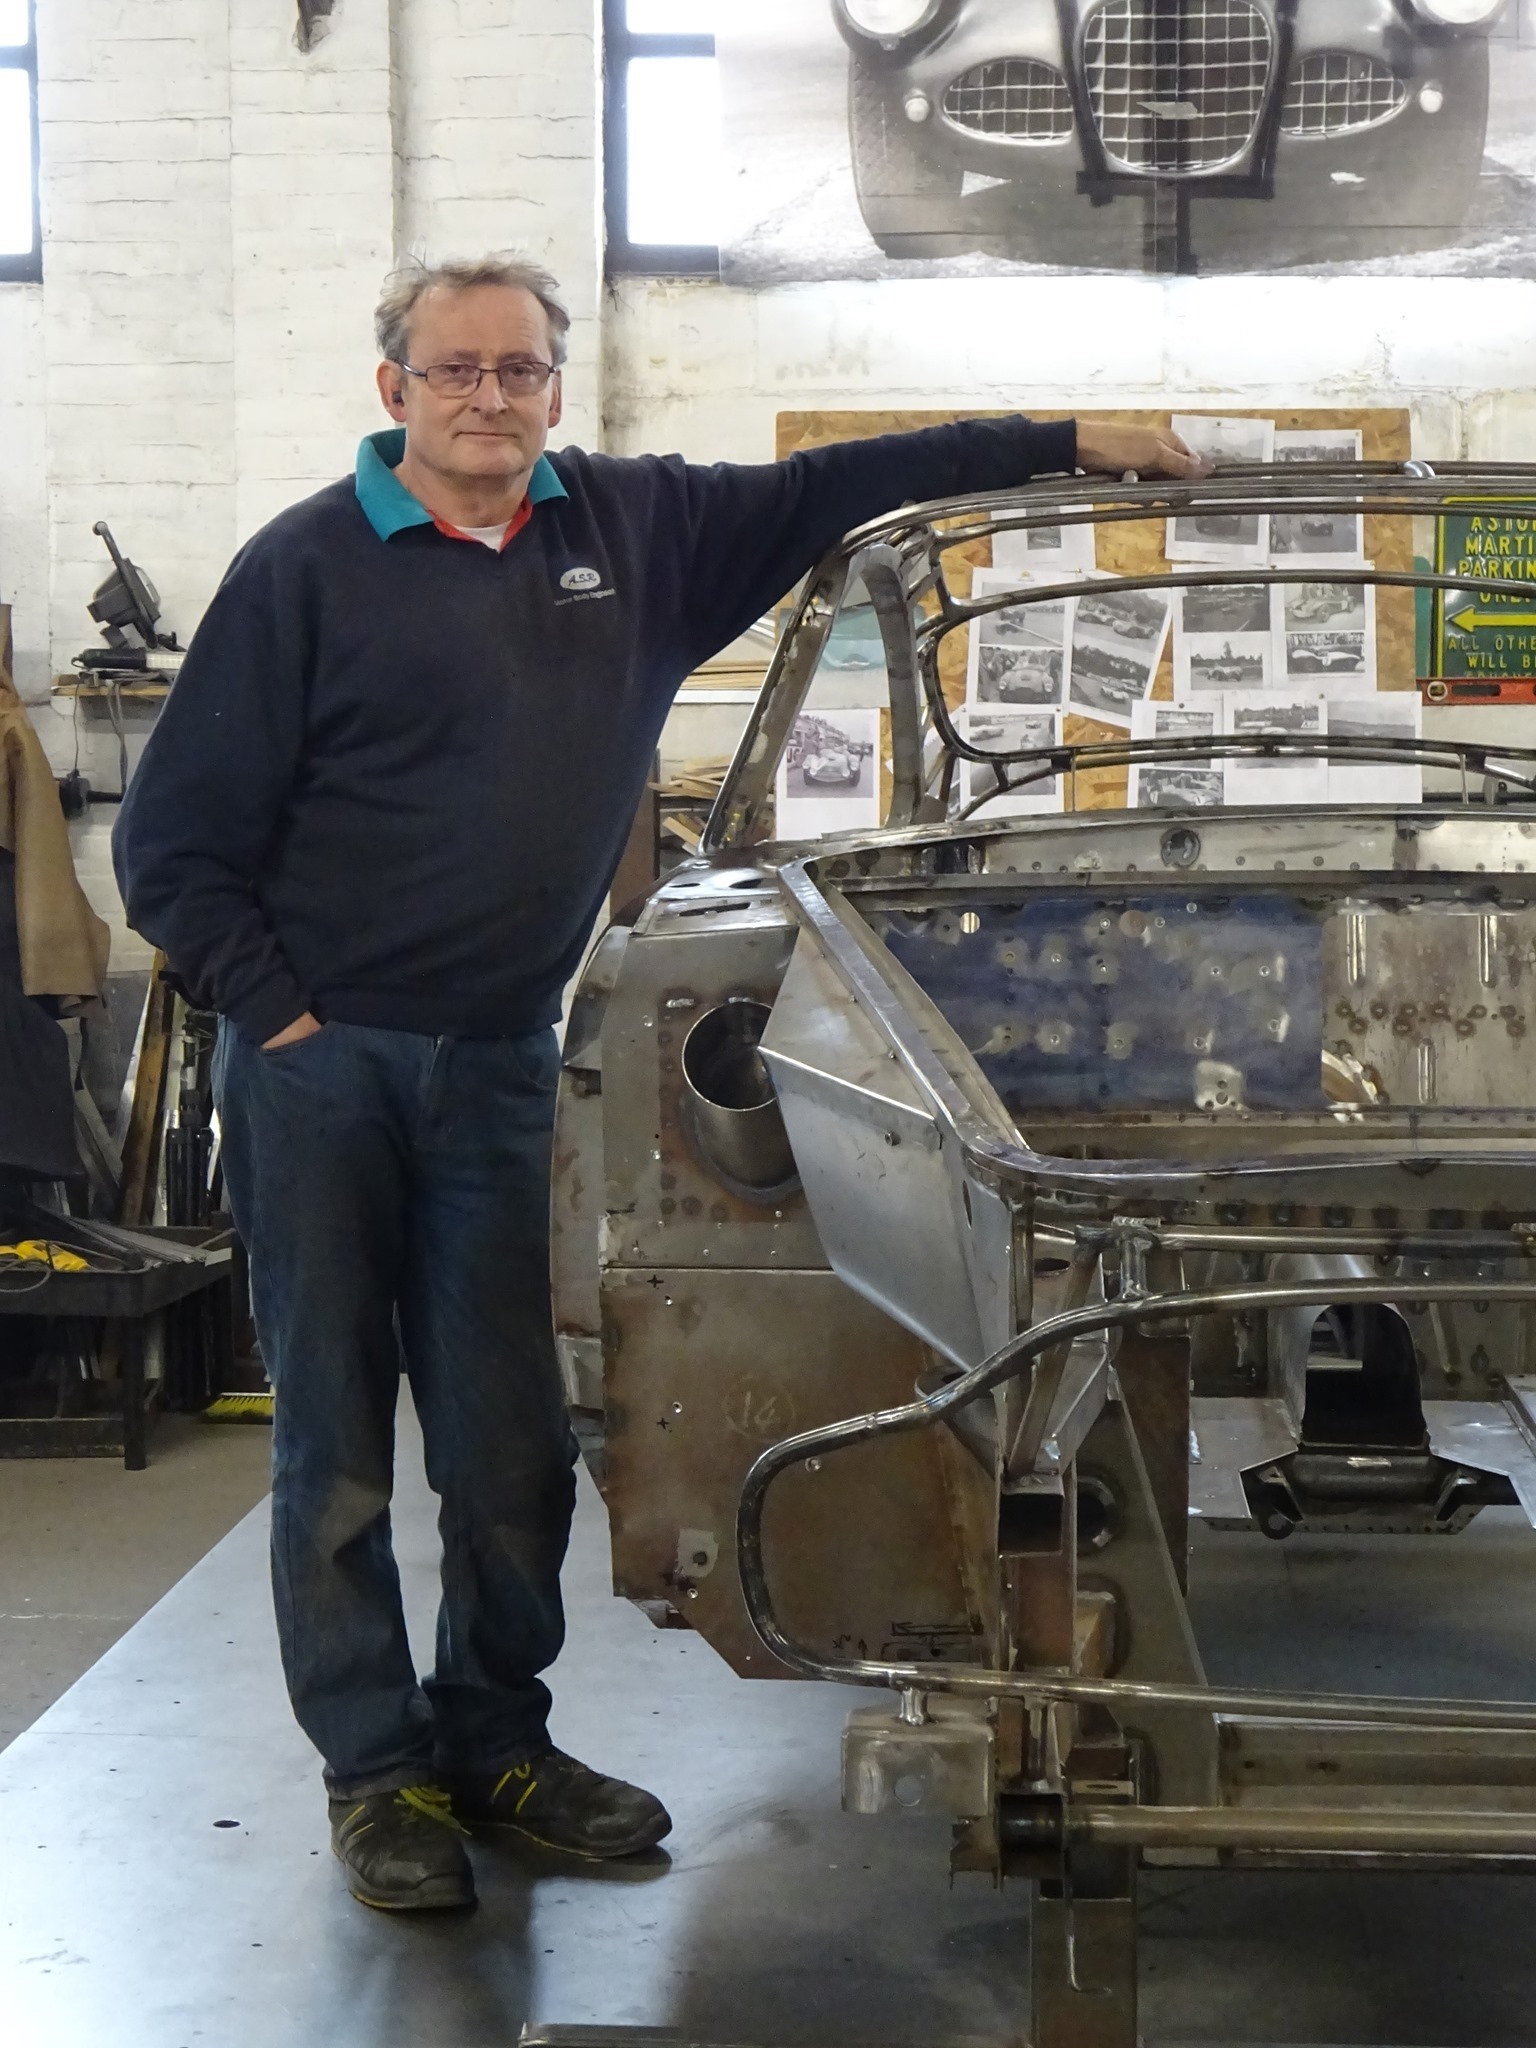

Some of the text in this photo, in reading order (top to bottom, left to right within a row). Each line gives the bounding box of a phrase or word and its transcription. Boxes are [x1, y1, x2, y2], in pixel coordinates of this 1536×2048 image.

[1448, 636, 1480, 650] ALL
[1467, 654, 1536, 669] WILL B
